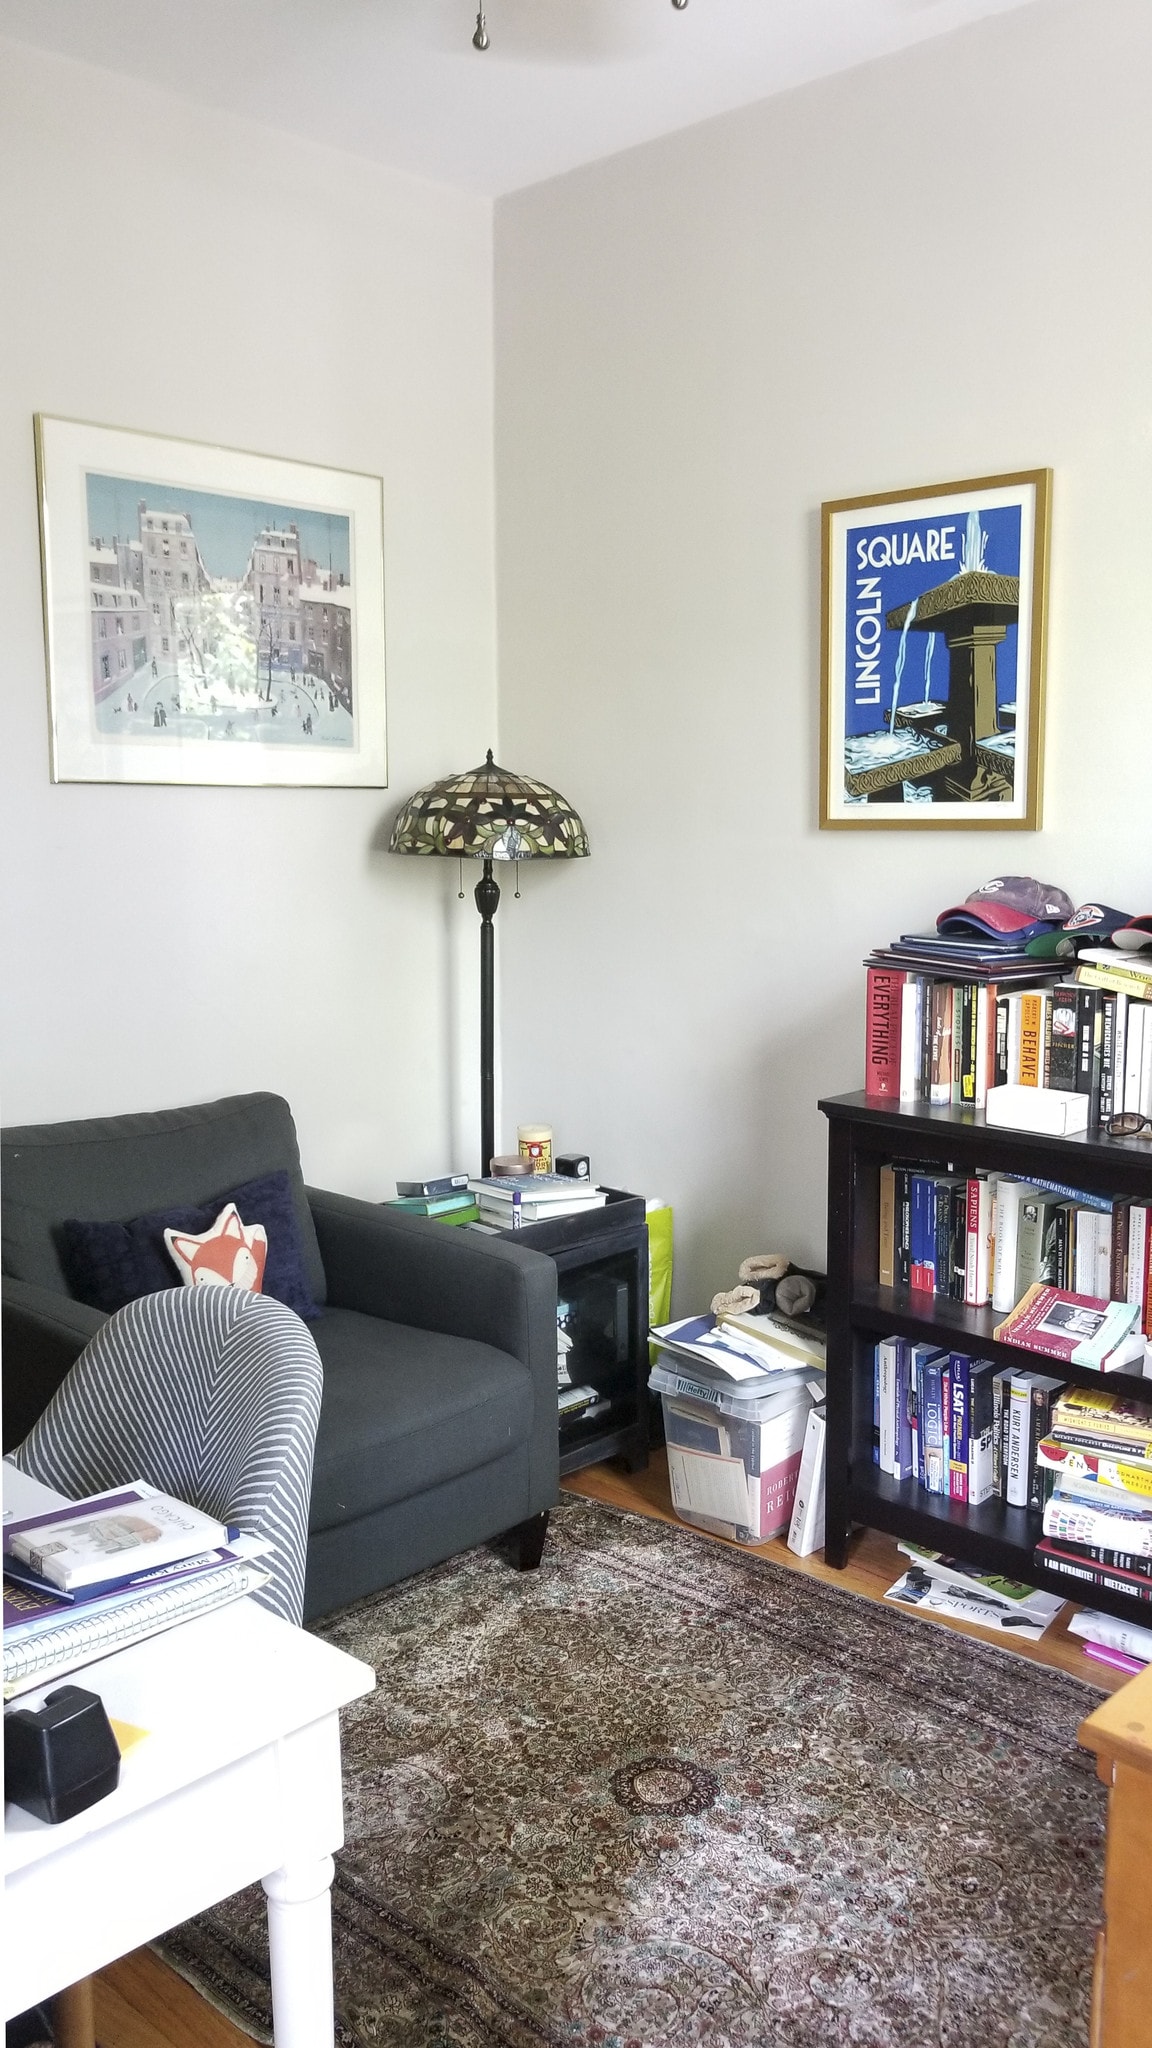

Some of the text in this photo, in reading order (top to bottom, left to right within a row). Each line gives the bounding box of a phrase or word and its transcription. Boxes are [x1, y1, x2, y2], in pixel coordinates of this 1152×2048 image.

[856, 527, 956, 571] SQUARE
[855, 577, 882, 705] LINCOLN
[872, 976, 891, 1065] EVERYTHING
[1104, 1017, 1112, 1058] DEMOCRACIES
[1022, 1030, 1037, 1079] BEHAVE
[1012, 1314, 1032, 1333] INDIAN
[1029, 1288, 1051, 1317] SUMMER
[1003, 1335, 1068, 1358] INDIAN SUMMER
[688, 1384, 709, 1398] Hefty
[953, 1383, 963, 1415] LSAT
[927, 1402, 937, 1445] LOGIC
[1010, 1409, 1021, 1480] KURT ANDERSEN
[150, 1504, 195, 1531] CHICAGO
[173, 1557, 210, 1571] Mary
[1044, 1557, 1094, 1582] I AM DYNAMITE!
[1104, 1577, 1139, 1596] NIETZSCHE
[945, 1599, 1002, 1620] SPORTS
